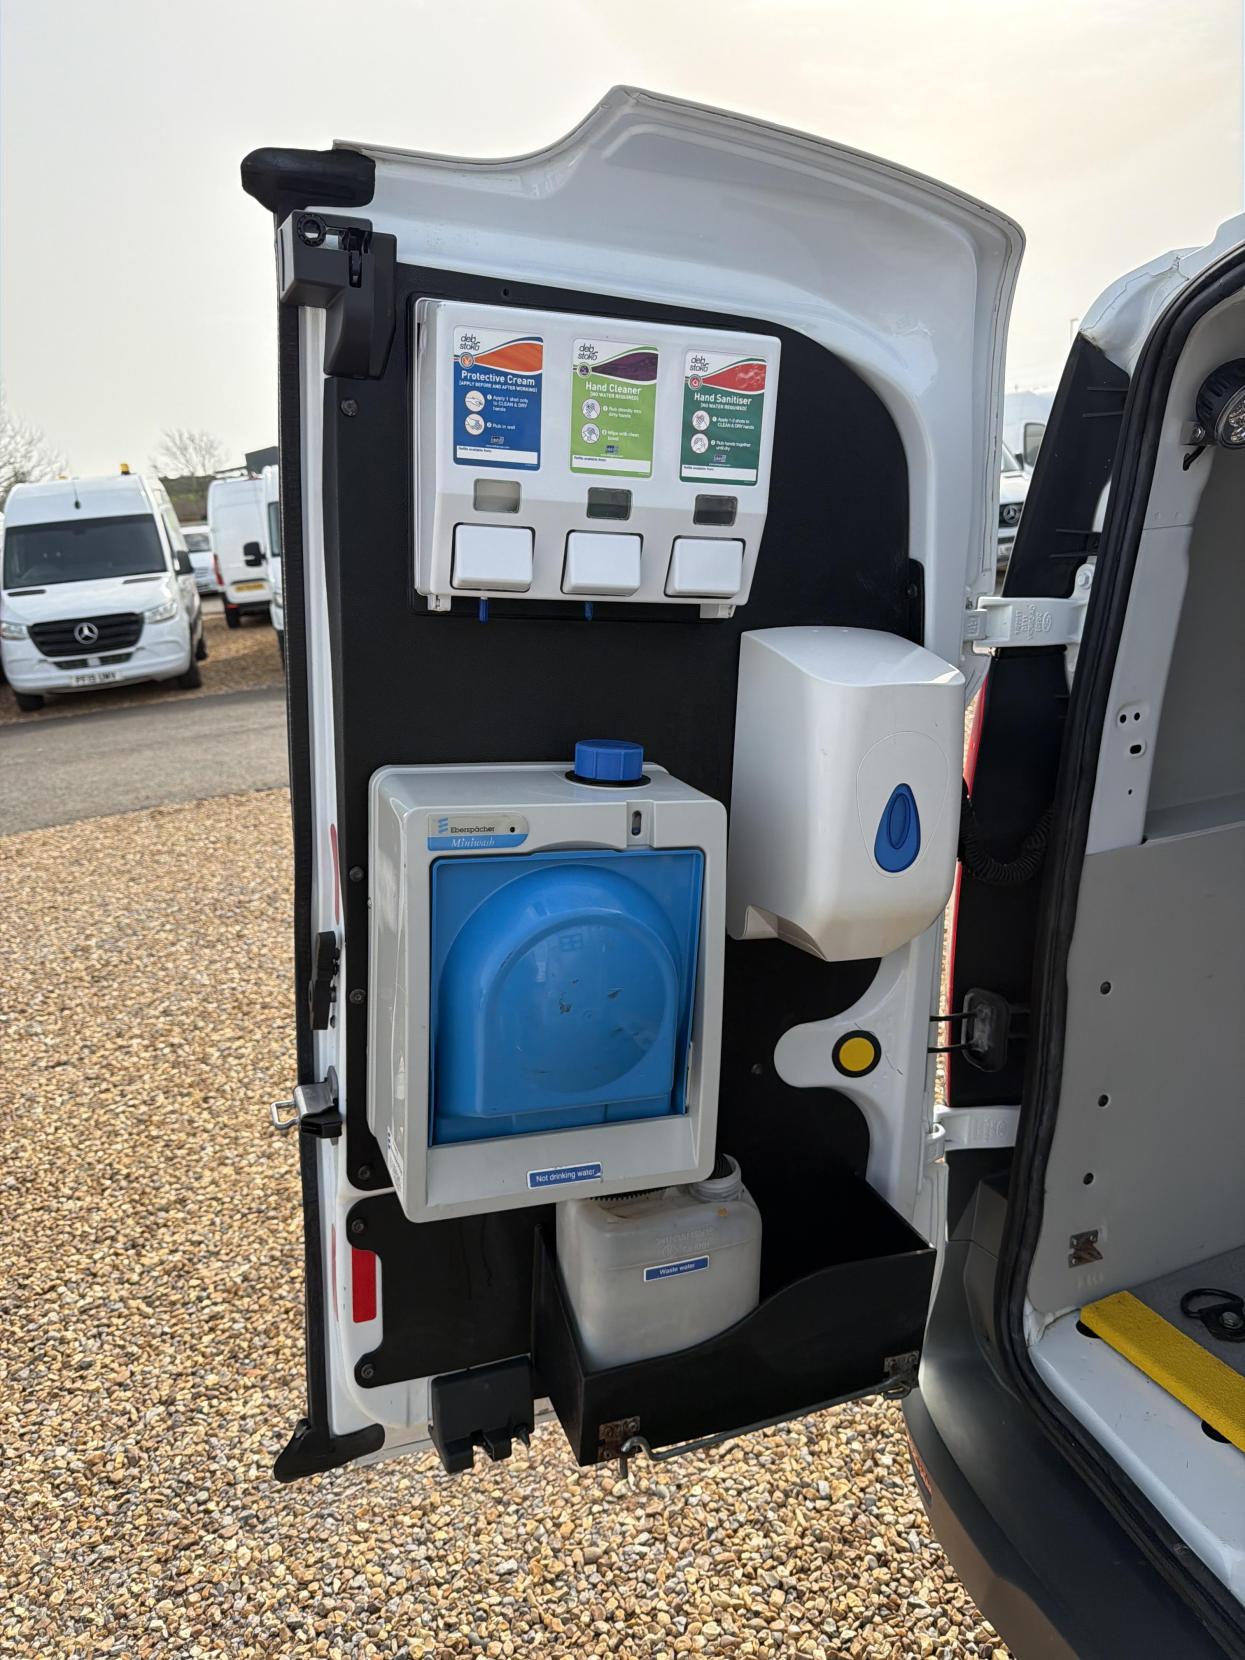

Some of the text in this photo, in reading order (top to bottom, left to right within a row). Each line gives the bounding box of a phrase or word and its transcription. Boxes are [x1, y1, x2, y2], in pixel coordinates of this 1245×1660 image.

[460, 332, 476, 342] deb
[579, 343, 594, 352] deb
[691, 355, 705, 364] deb
[461, 370, 535, 385] Protective Cream
[586, 381, 641, 395] Hand Cleaner
[694, 392, 752, 405] Hand Sanitiser
[451, 837, 496, 848] Miniwash
[536, 1169, 595, 1183] Not drinking water
[660, 1263, 695, 1275] Waste water
